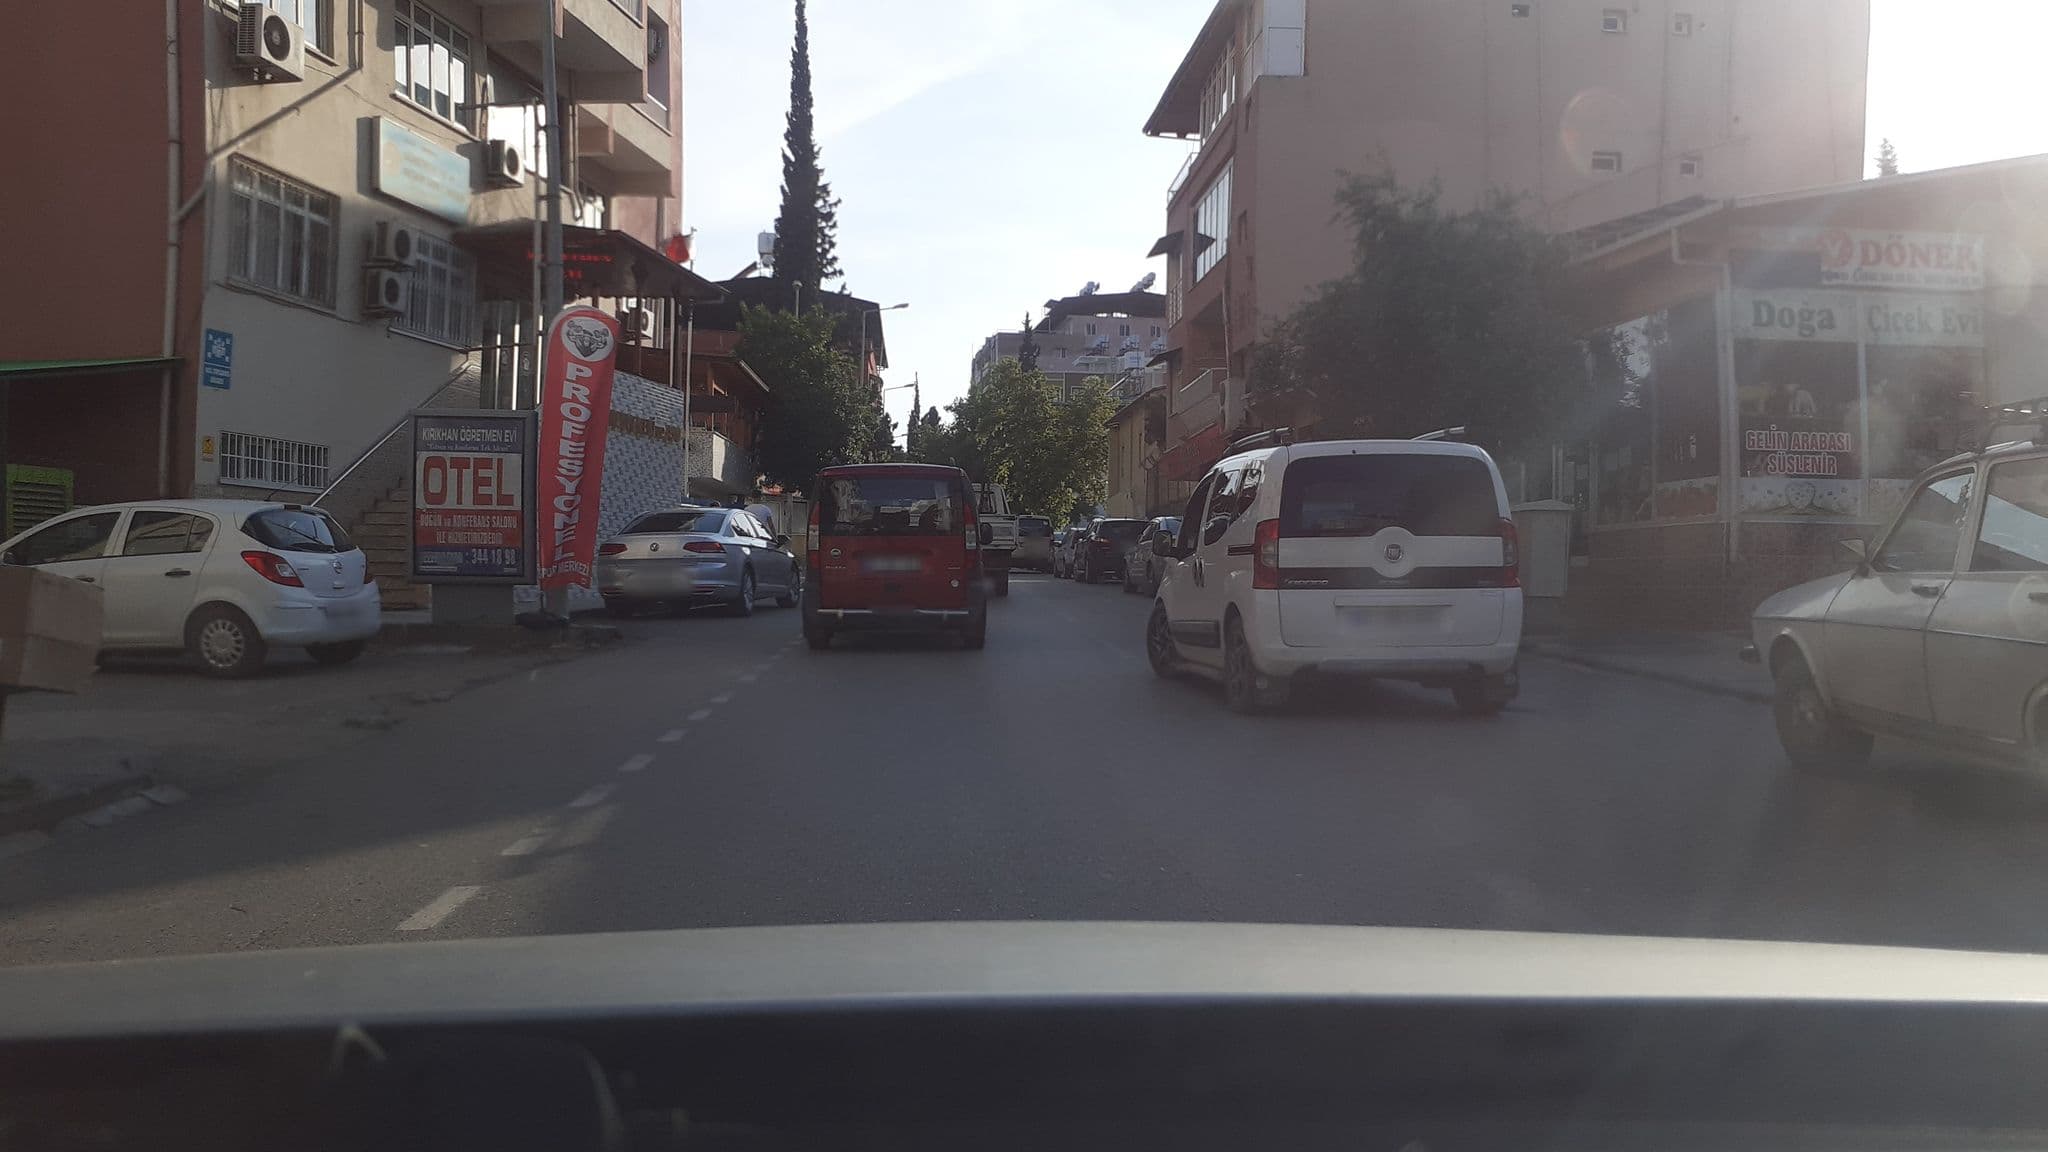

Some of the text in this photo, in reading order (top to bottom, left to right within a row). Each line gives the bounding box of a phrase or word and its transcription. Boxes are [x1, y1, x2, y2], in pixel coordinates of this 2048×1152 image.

[1859, 233, 1978, 272] DÖNER
[1751, 299, 1983, 341] Doğa Çiçek Evi
[422, 427, 459, 441] KIRIKHAN
[460, 425, 503, 442] ÖĞRETMEN
[1746, 424, 1851, 453] GELİN ARABASI
[553, 361, 592, 562] PROFESYONEL
[1767, 451, 1838, 476] SÜSLENİR
[423, 455, 515, 507] OTEL
[491, 515, 518, 529] SALONU
[471, 548, 489, 565] 344
[491, 548, 503, 565] 18
[504, 548, 517, 565] 98
